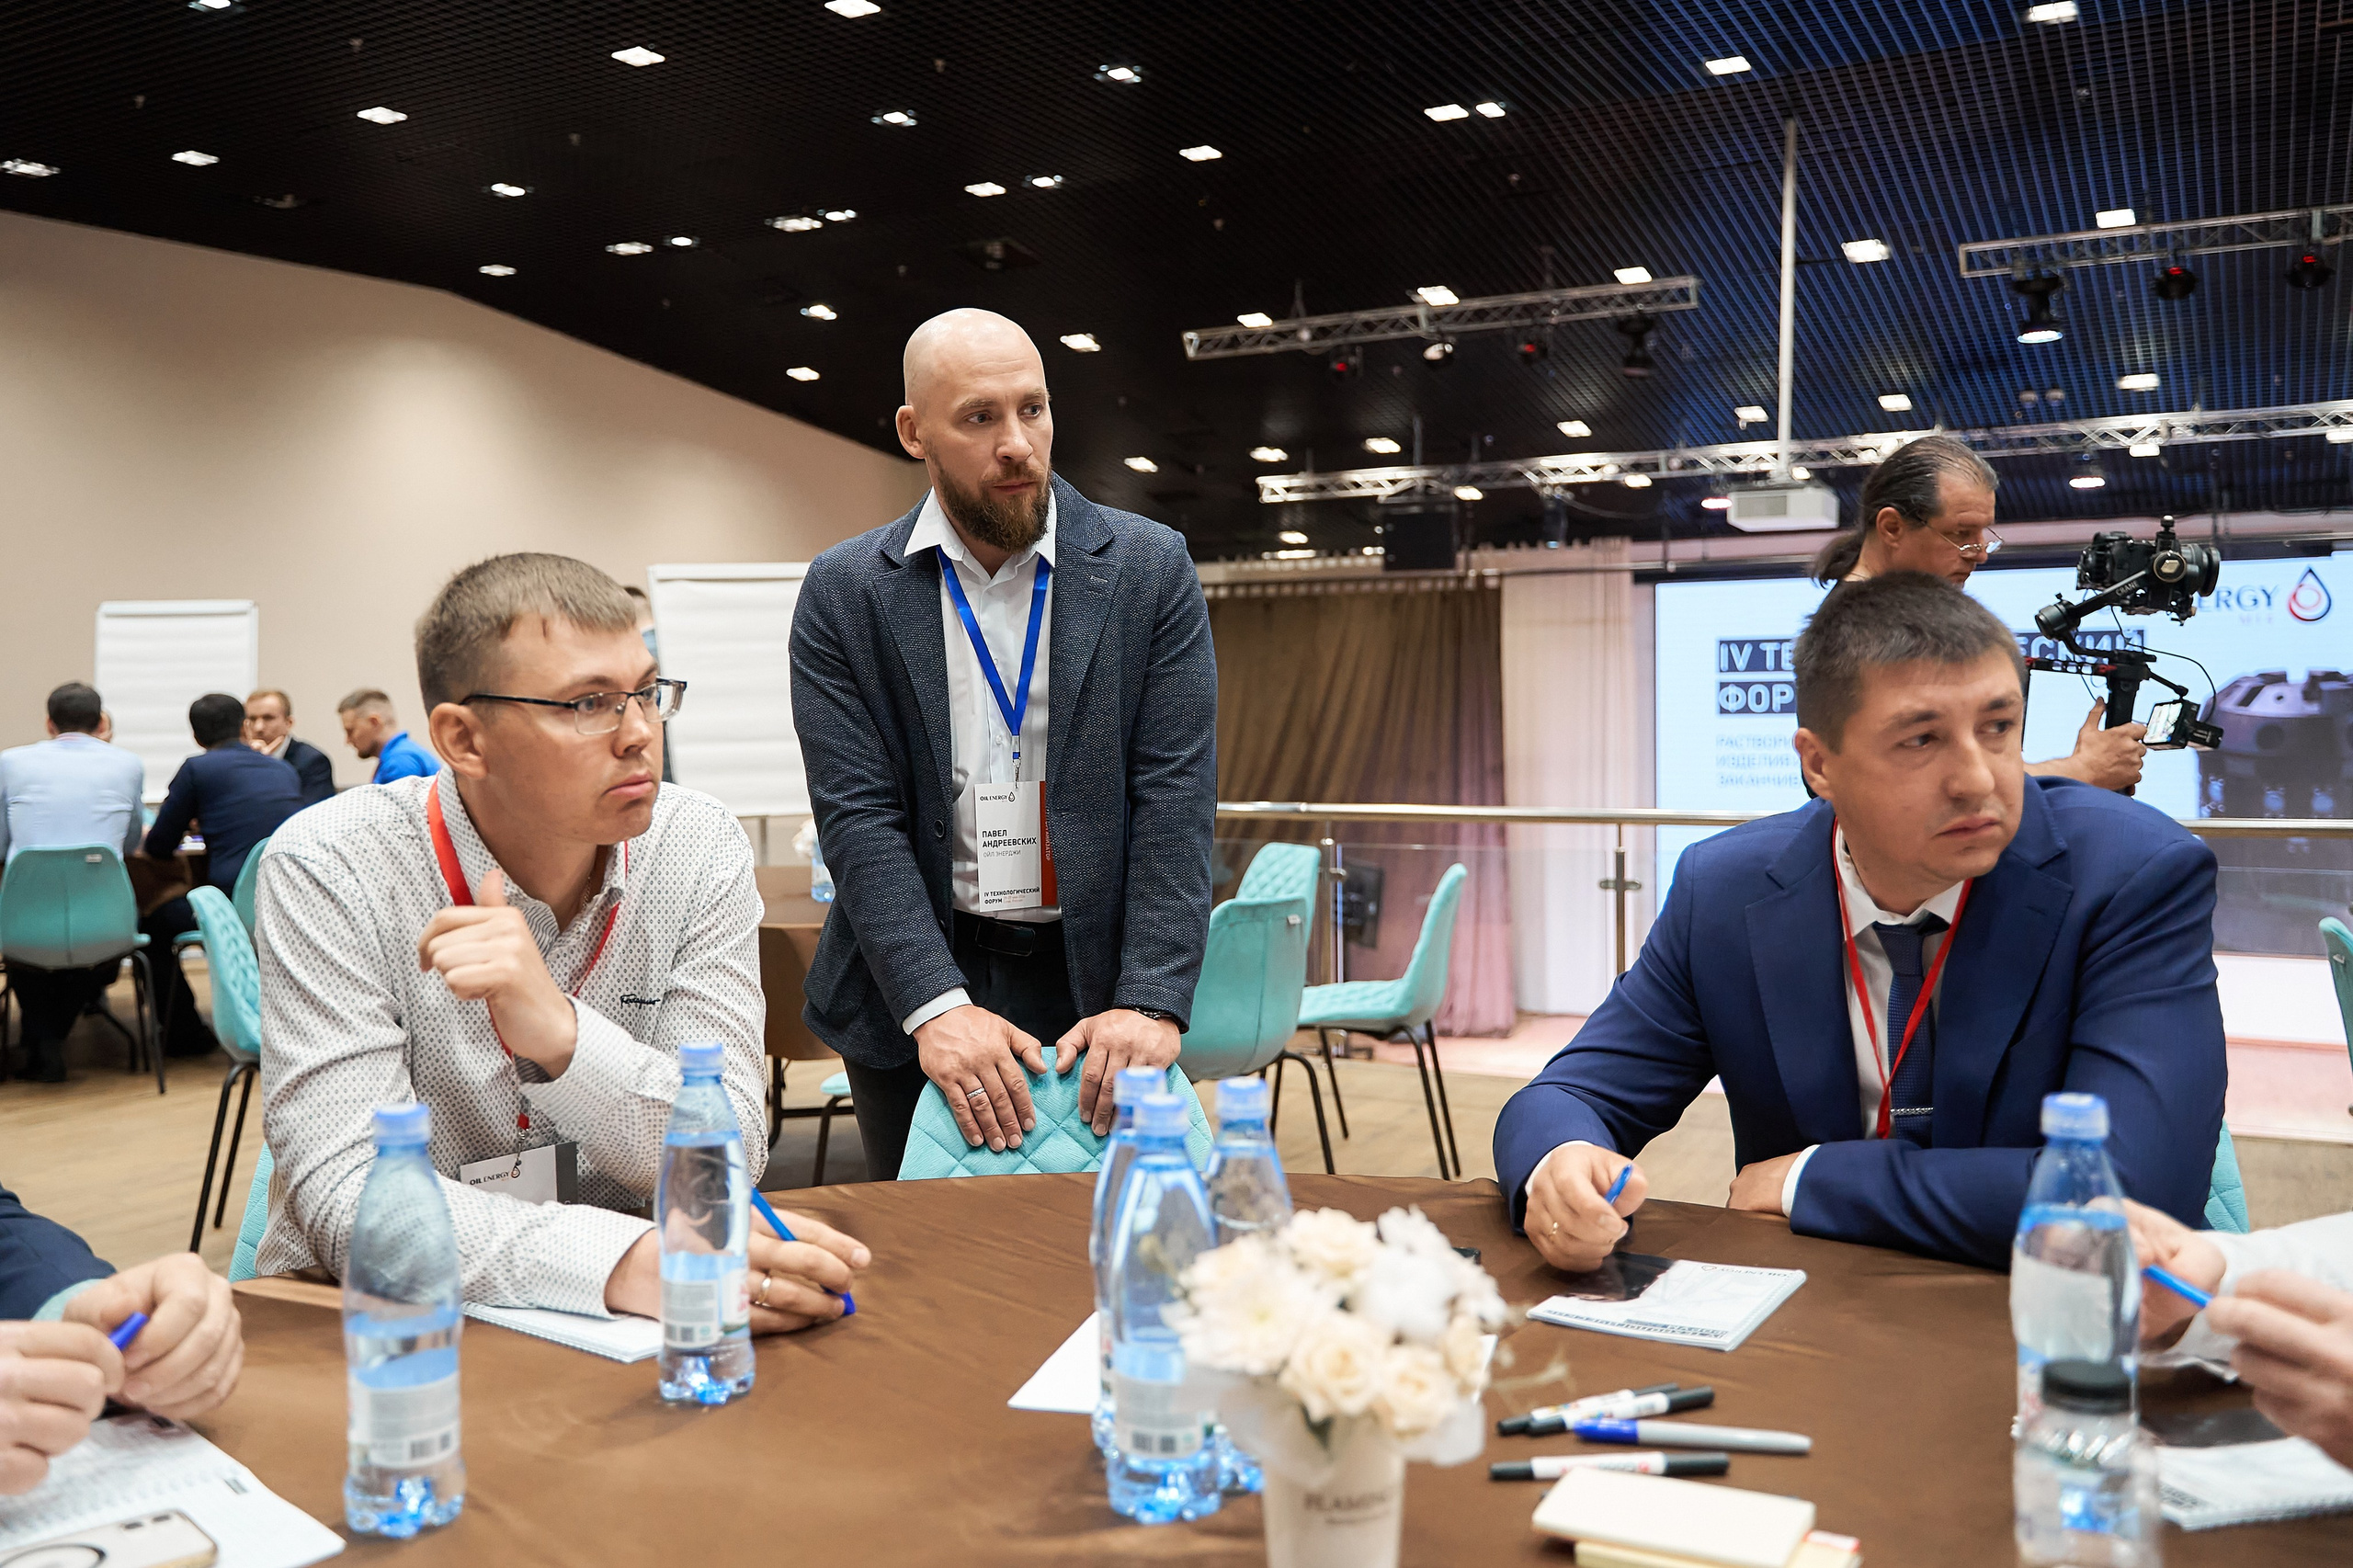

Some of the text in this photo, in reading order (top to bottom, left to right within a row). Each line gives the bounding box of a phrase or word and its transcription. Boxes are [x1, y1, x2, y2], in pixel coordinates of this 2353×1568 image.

[2115, 580, 2141, 597] CRANE
[2198, 585, 2279, 611] ERGY
[1720, 642, 1753, 672] IV
[1759, 642, 1796, 671] ТЕ
[1719, 683, 1795, 713] ФОР
[982, 829, 1007, 838] ПАВЕЛ
[983, 837, 1037, 848] АНДРЕЕВСКИХ
[990, 887, 1040, 896] ТЕХНОЛОГИЧЕСКИЙ
[470, 1177, 483, 1186] OIL
[483, 1172, 510, 1182] ENERGY
